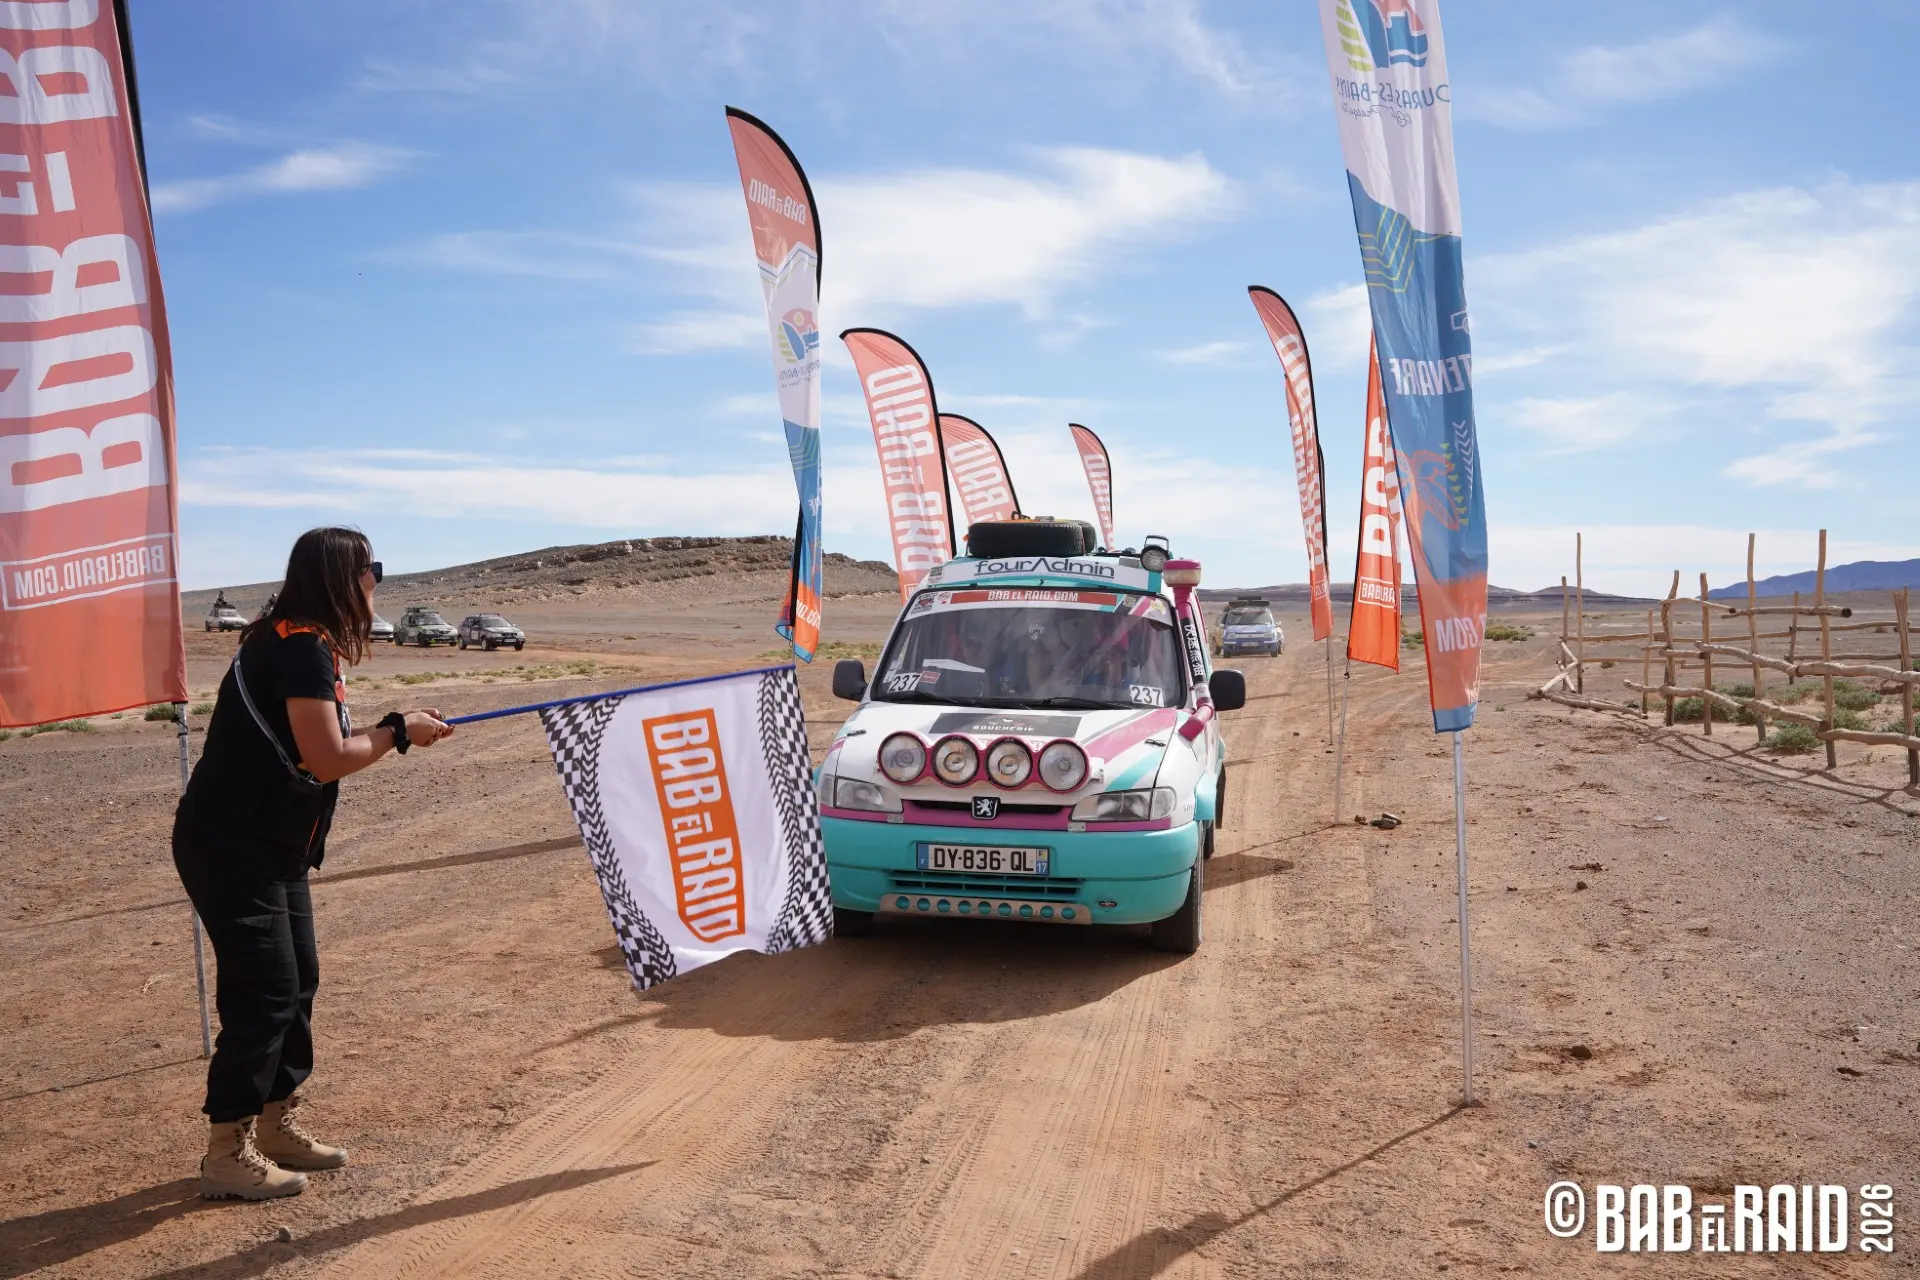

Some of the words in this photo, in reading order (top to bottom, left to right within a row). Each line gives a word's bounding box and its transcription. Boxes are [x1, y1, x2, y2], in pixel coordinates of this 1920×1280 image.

[988, 590, 1009, 601] BAB
[1012, 591, 1022, 600] EL
[1024, 591, 1078, 602] RAID.COM
[889, 674, 921, 692] 237
[1131, 686, 1162, 706] 237
[652, 717, 722, 809] BAB
[671, 812, 714, 845] EL
[933, 847, 1035, 872] DY-836-QL
[1036, 862, 1047, 873] 17
[677, 837, 739, 938] RAID
